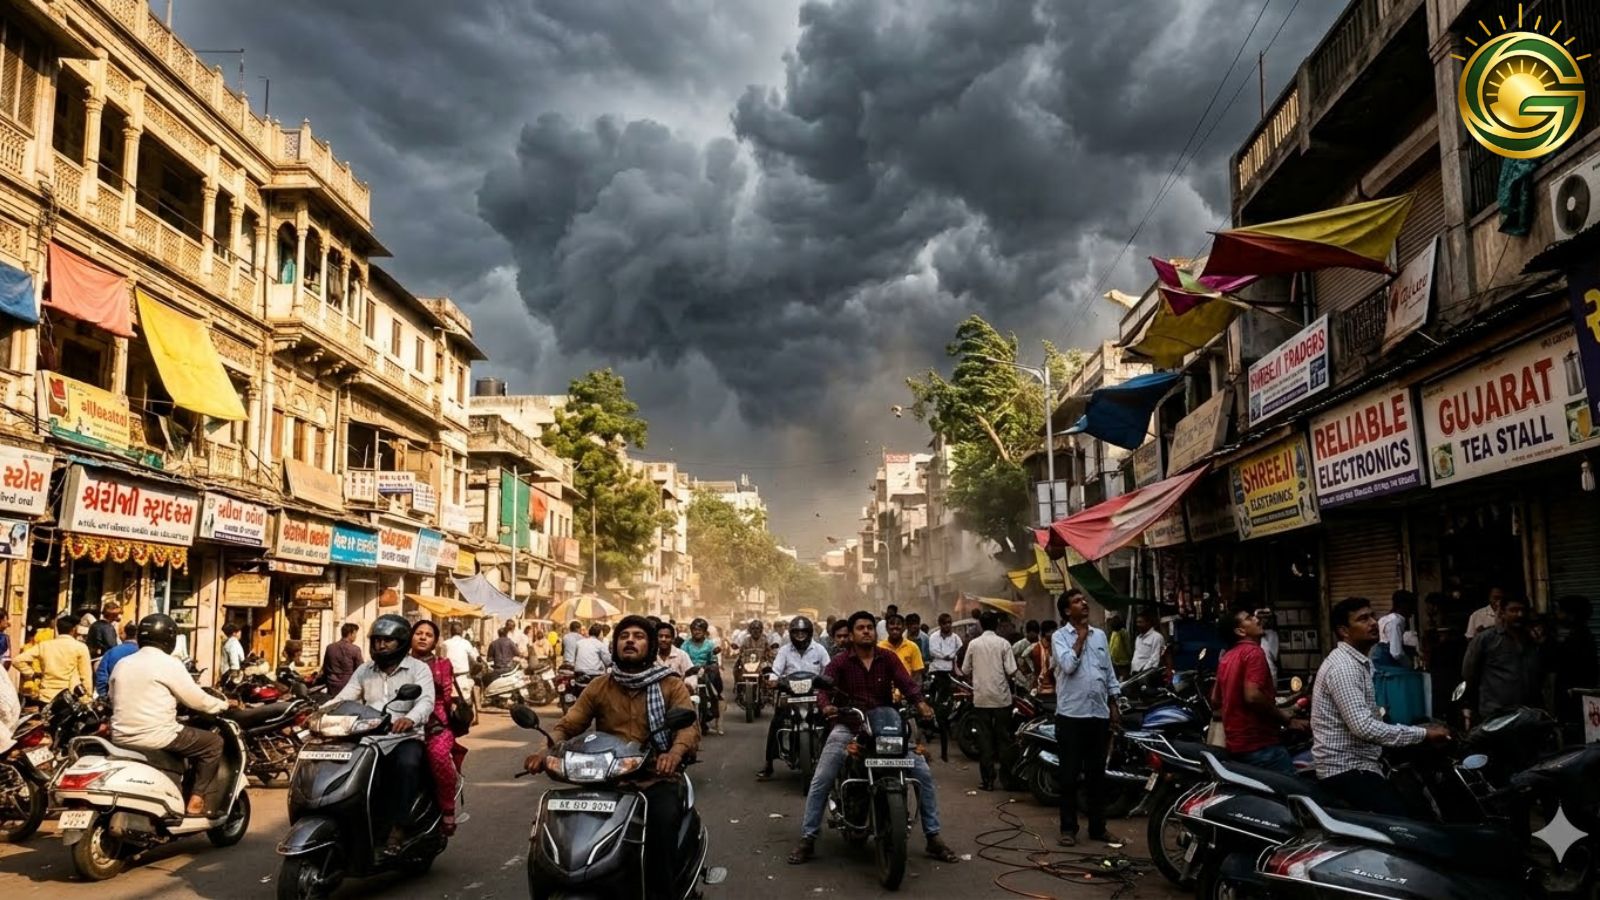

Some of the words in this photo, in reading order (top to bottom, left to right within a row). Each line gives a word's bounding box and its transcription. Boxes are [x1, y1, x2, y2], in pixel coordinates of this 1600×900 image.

[1439, 357, 1553, 436] GUJARAT
[1314, 393, 1408, 461] RELIABLE
[1460, 433, 1494, 464] TEA
[1496, 415, 1554, 455] STALL
[1242, 449, 1295, 495] SHREEJI
[1318, 438, 1411, 490] ELECTRONICS
